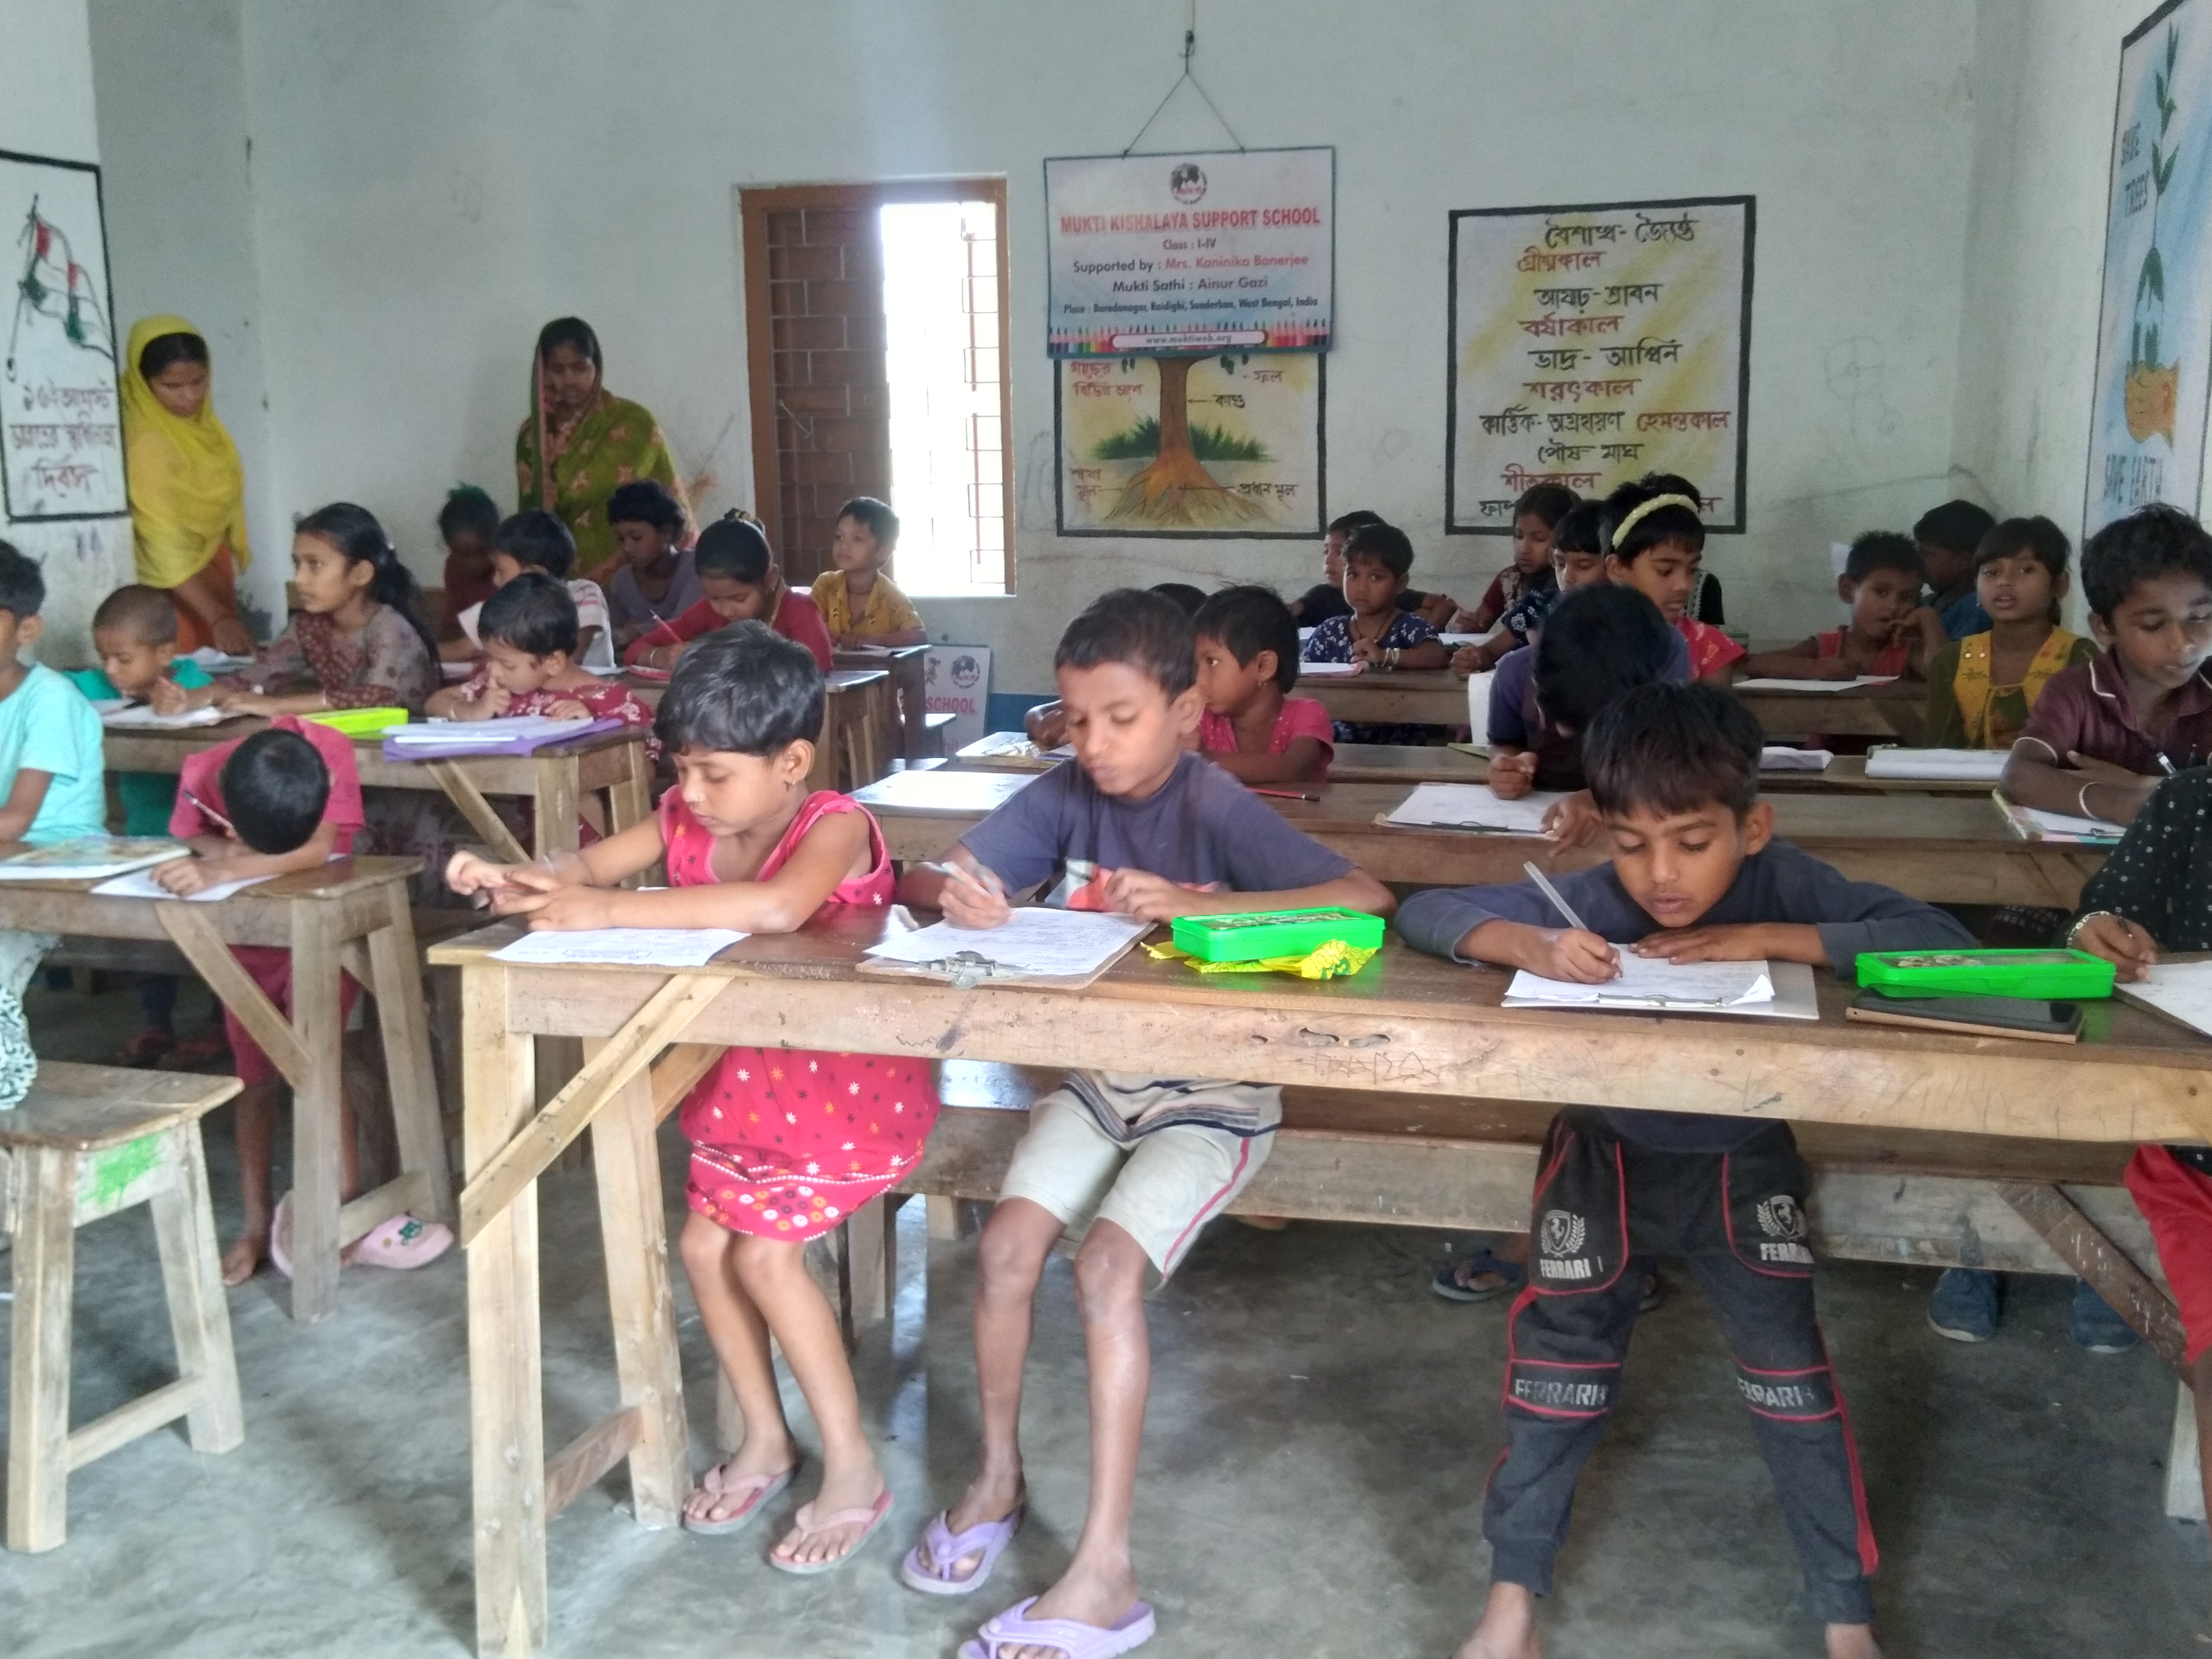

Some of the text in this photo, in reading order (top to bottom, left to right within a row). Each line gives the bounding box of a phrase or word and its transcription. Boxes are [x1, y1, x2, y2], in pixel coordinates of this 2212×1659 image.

[1061, 207, 1321, 233] MUKTI KISHALAYA SUPPORT SCHOOL
[1163, 239, 1188, 250] Class
[1073, 258, 1135, 274] Supported
[1139, 258, 1153, 273] by
[1165, 257, 1191, 269] Mrs.
[1195, 256, 1250, 268] Kaninika
[1253, 253, 1309, 267] Banerjee
[1112, 280, 1149, 293] Mukti
[1153, 278, 1186, 292] Sathi
[1197, 278, 1234, 290] Ainur
[1238, 275, 1268, 289] Gazi
[1064, 303, 1086, 314] Place
[1296, 296, 1319, 306] India
[926, 697, 976, 714] SCHOOL
[1540, 1258, 1592, 1279] FERRARI
